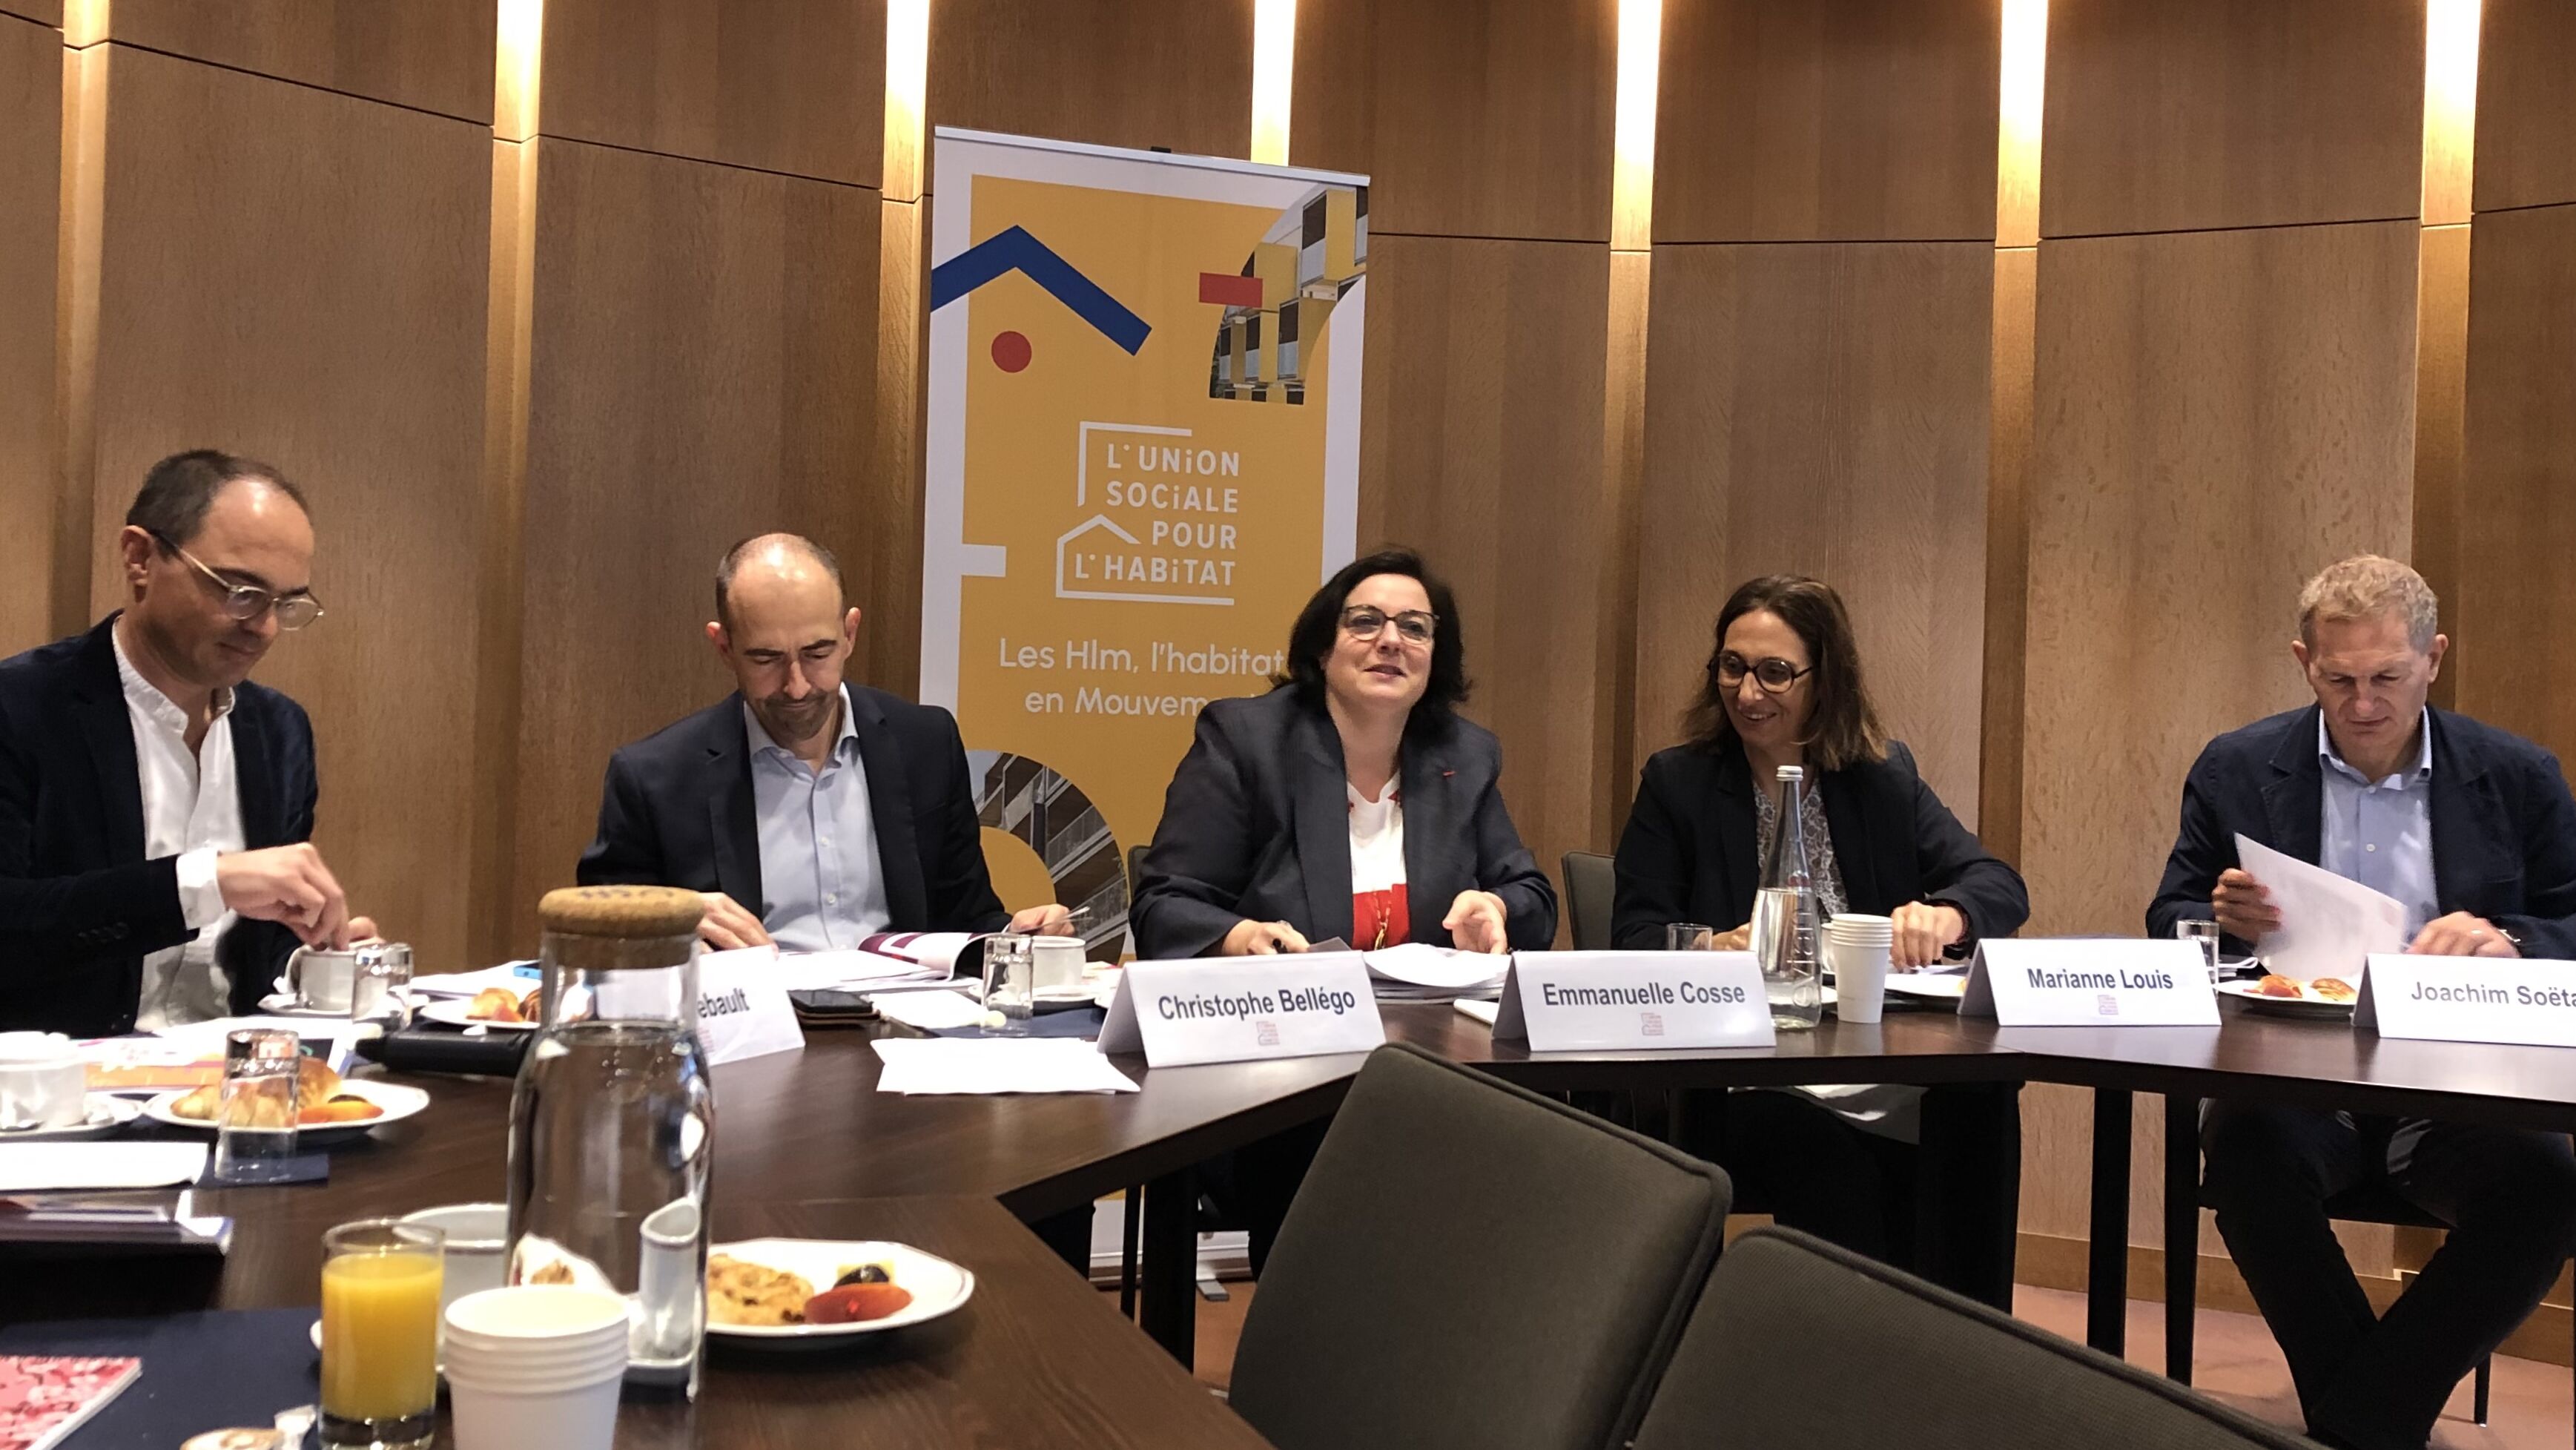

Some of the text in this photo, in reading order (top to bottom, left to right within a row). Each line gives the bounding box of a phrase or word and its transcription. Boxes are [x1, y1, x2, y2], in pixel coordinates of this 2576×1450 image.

[1152, 520, 1238, 550] POUR
[999, 638, 1285, 676] Les Hlm, l'habitat
[1025, 687, 1255, 717] en Mouvem
[1542, 981, 1746, 1006] Emmanuelle Cosse
[2027, 968, 2174, 989] Marianne Louis
[2411, 981, 2510, 1004] Joachim
[697, 987, 750, 1019] ebault
[1157, 986, 1355, 1021] Christophe Bellégo
